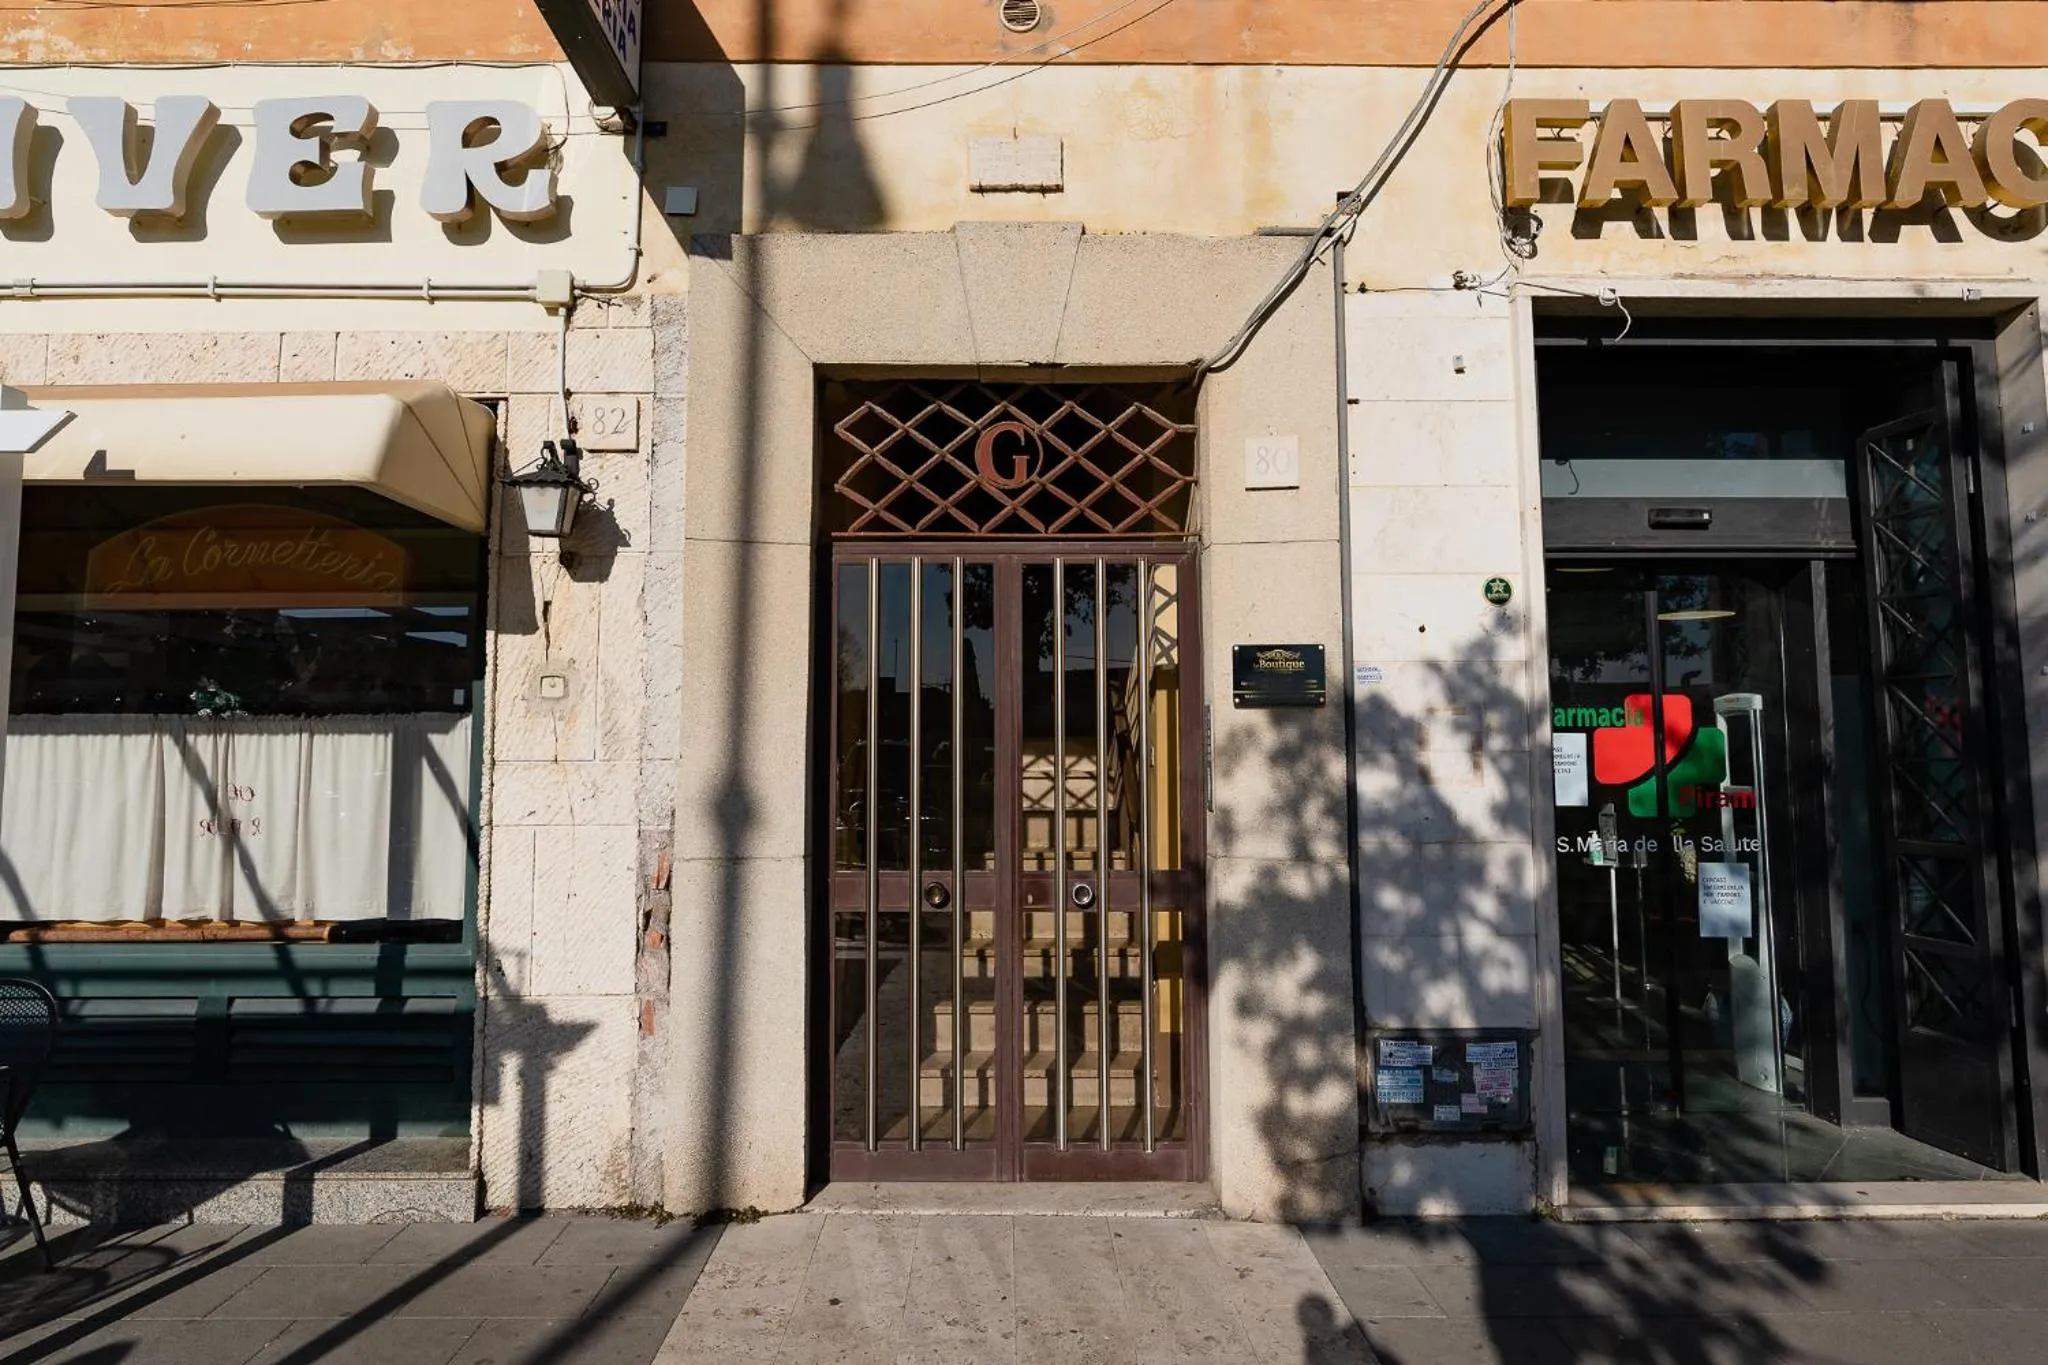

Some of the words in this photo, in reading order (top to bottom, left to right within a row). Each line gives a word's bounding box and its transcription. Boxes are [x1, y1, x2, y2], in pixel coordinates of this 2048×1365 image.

[1504, 98, 2048, 207] FARMAC
[592, 406, 632, 435] 82
[975, 421, 1031, 489] G
[1255, 446, 1291, 475] 80
[183, 525, 398, 596] Cornetteria
[1259, 659, 1305, 671] Boutique
[1551, 702, 1645, 728] armacia
